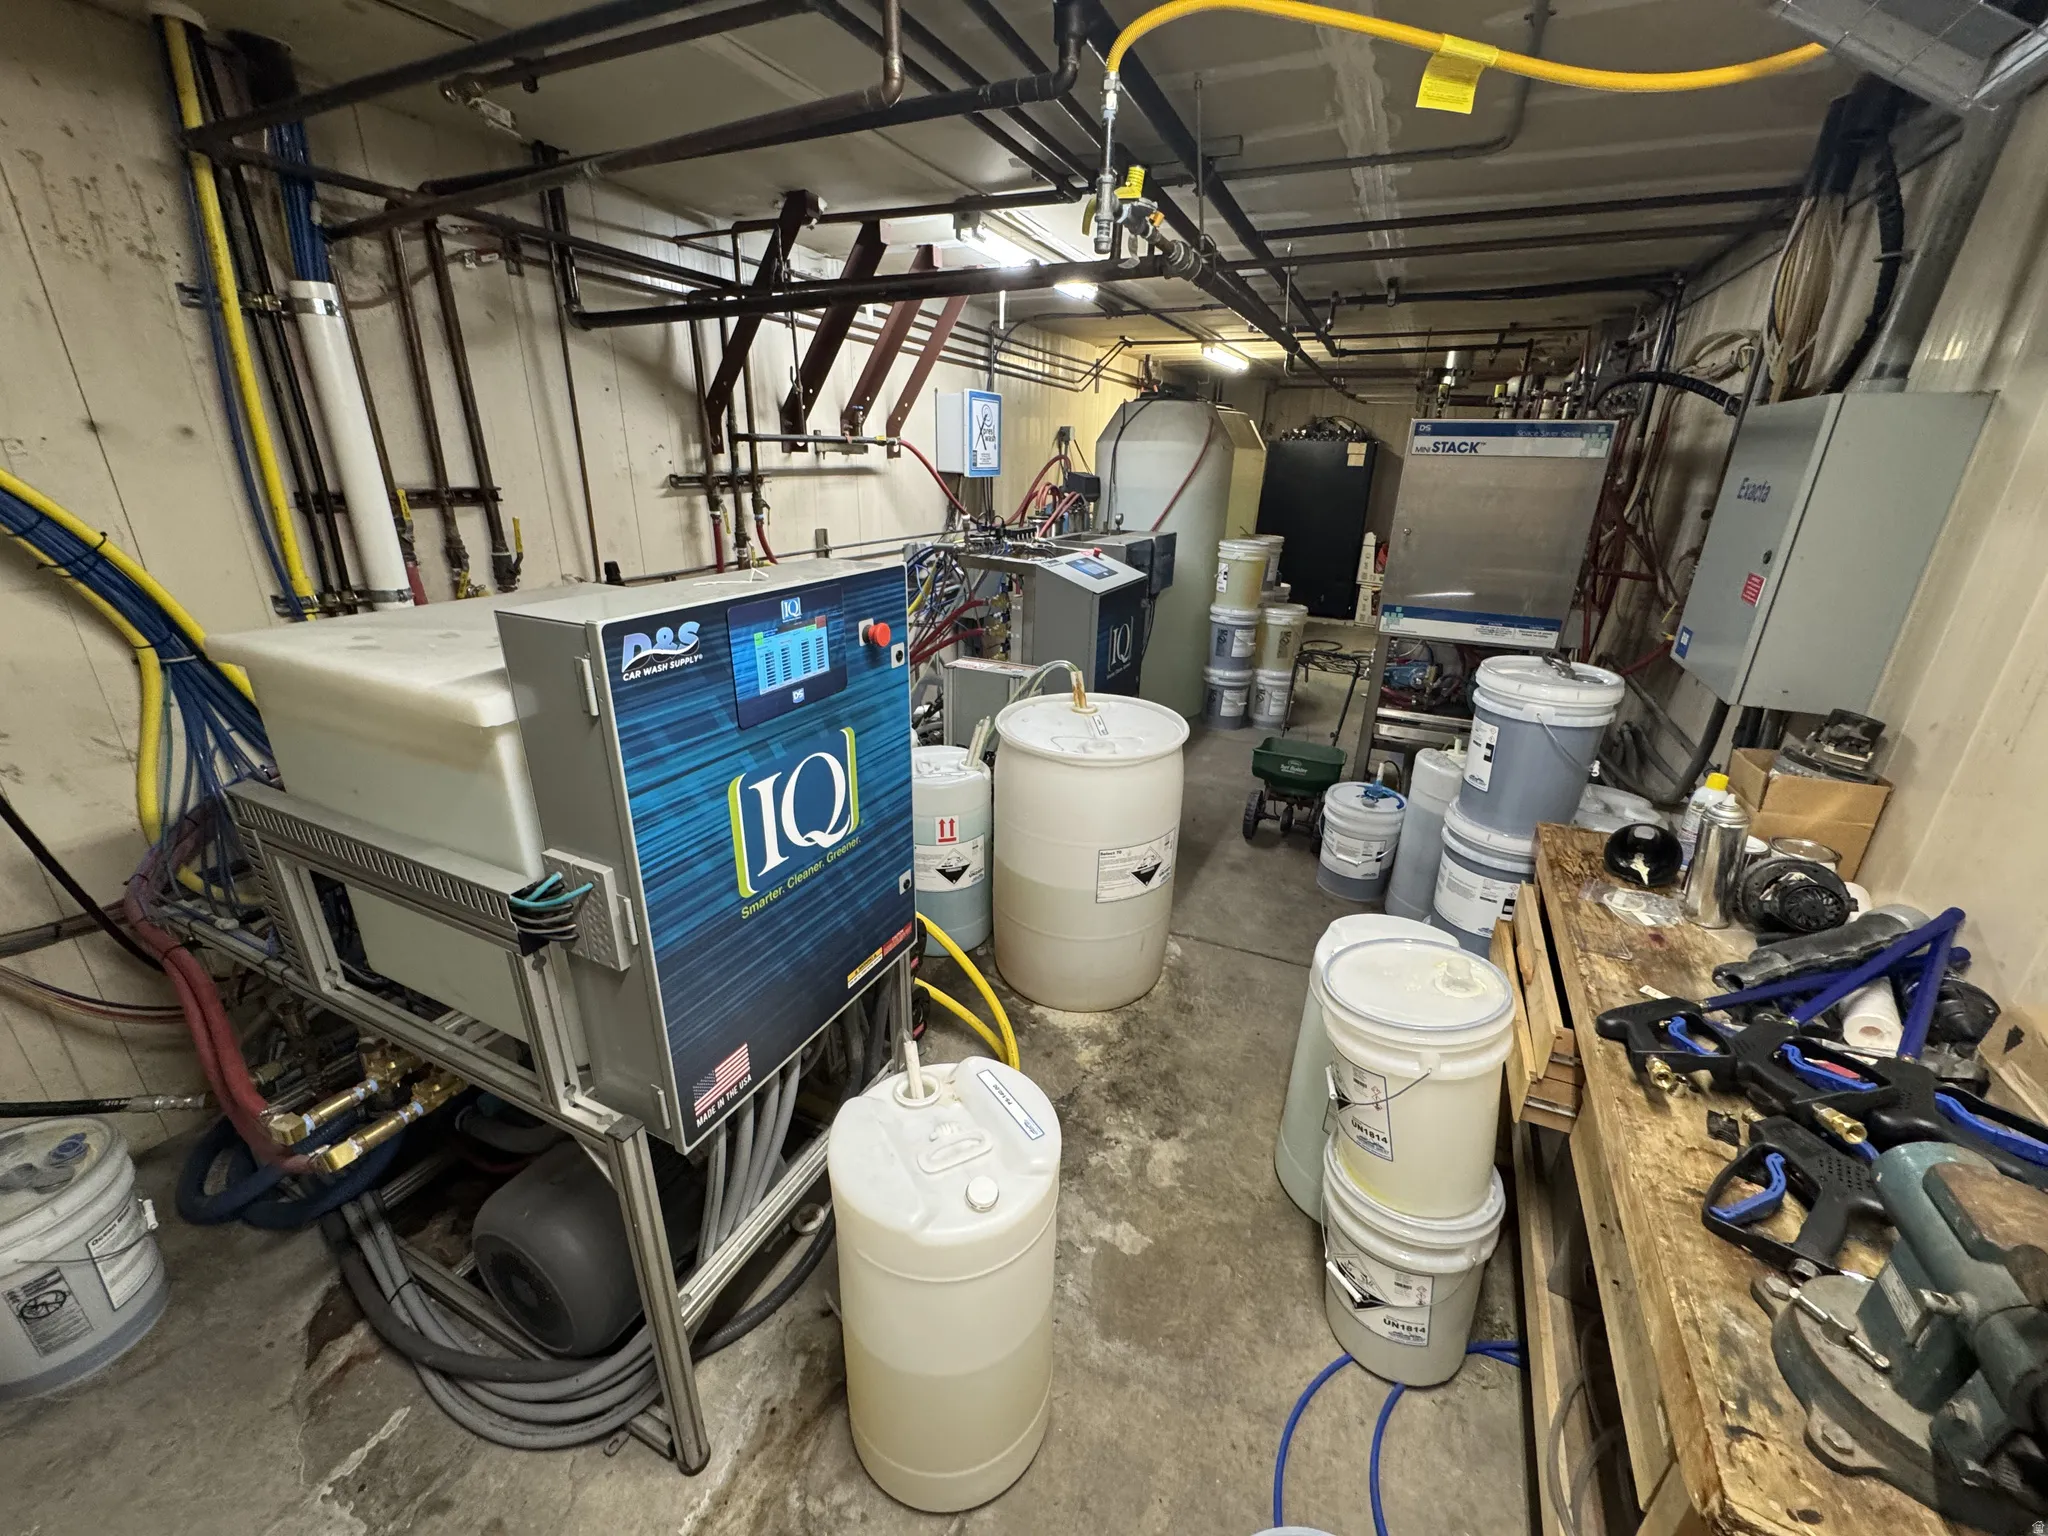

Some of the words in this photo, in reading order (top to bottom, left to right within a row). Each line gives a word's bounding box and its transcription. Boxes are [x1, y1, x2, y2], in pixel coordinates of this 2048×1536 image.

[783, 599, 800, 617] IQ
[622, 621, 701, 673] D&S
[1111, 623, 1130, 666] IQ
[623, 670, 641, 682] CAR
[643, 663, 668, 677] WASH
[748, 752, 851, 878] IQ
[741, 887, 785, 920] Smarter.
[787, 859, 825, 889] Cleaner.
[826, 835, 862, 863] Greener.
[697, 1105, 717, 1128] MADE
[717, 1098, 725, 1110] IN
[726, 1086, 739, 1102] THE
[739, 1074, 752, 1090] USA
[1351, 1119, 1388, 1144] UN1814
[91, 1223, 117, 1247] Ocean
[1383, 1318, 1426, 1333] UN1814
